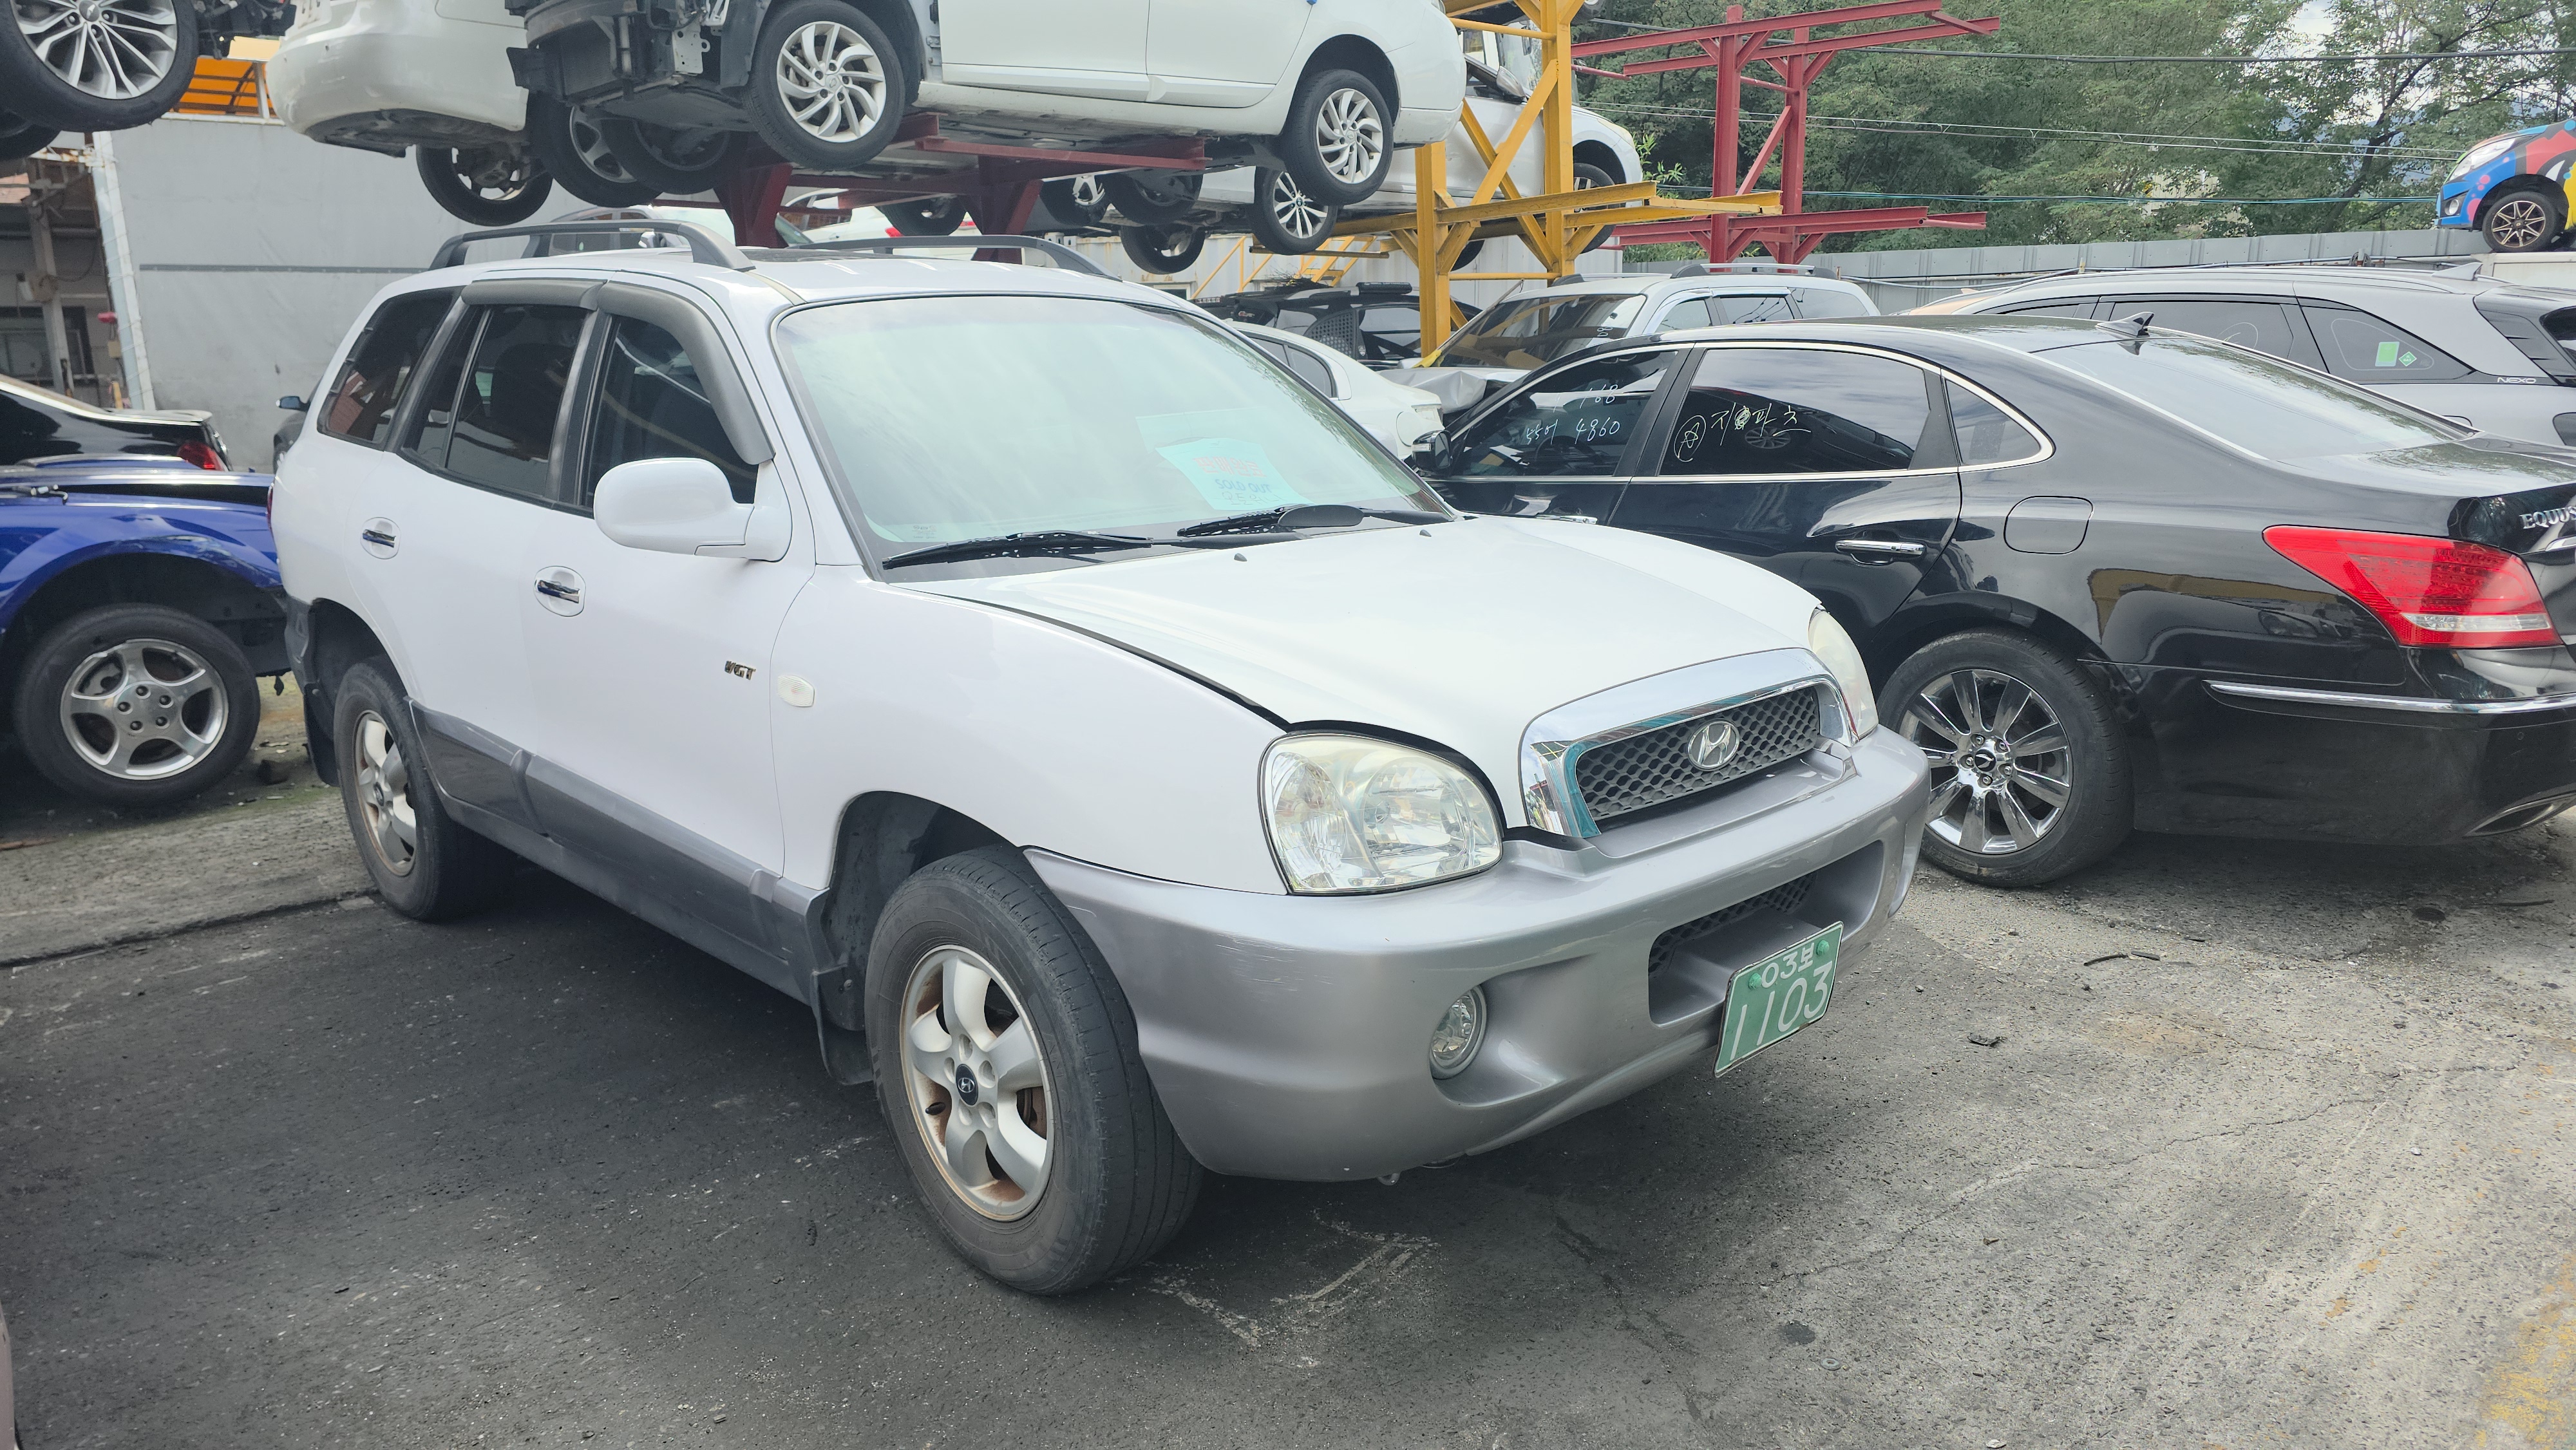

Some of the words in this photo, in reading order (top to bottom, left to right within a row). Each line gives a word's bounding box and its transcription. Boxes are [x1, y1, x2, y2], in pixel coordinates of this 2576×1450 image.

[1194, 456, 1267, 477] 판매완료
[1215, 479, 1245, 491] SOLD
[1248, 483, 1272, 493] OUT
[2519, 505, 2576, 529] EQUUS
[724, 660, 756, 681] VGT
[1761, 942, 1815, 988] 03보
[1730, 960, 1833, 1061] 1103
